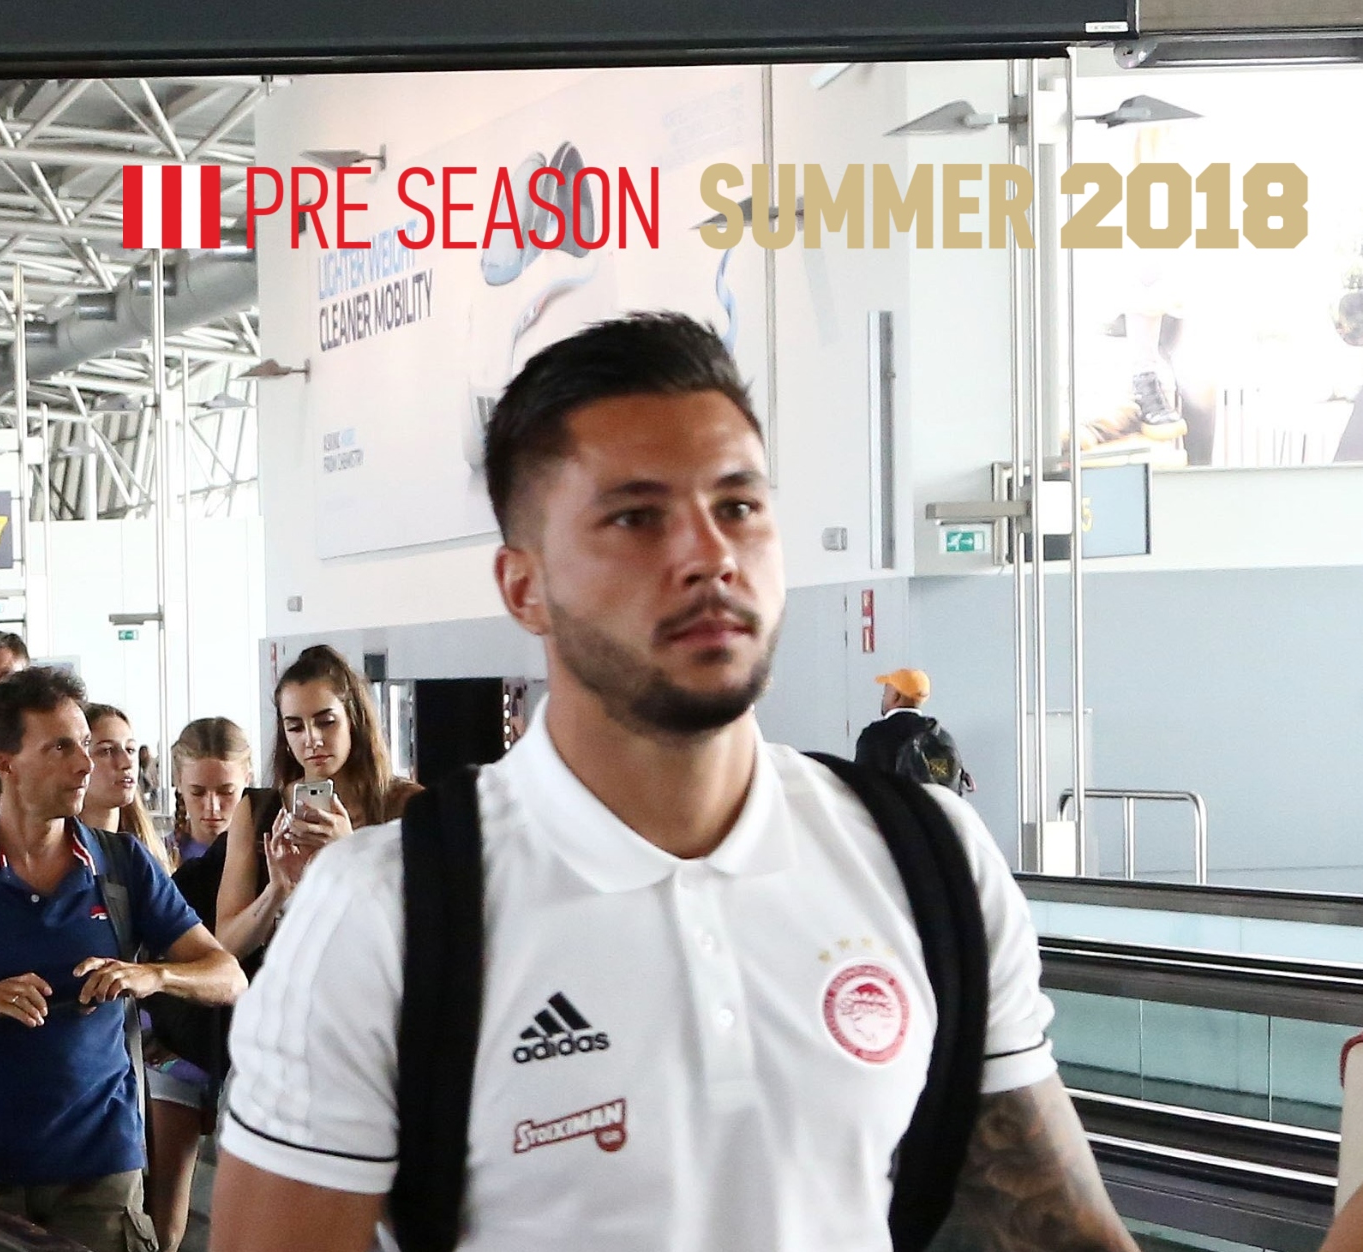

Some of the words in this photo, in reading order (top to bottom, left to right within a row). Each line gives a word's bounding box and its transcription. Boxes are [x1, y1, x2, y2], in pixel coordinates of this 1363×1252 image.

[319, 291, 372, 352] CLEANER
[374, 268, 433, 335] MOBILITY
[512, 1032, 611, 1064] adidas
